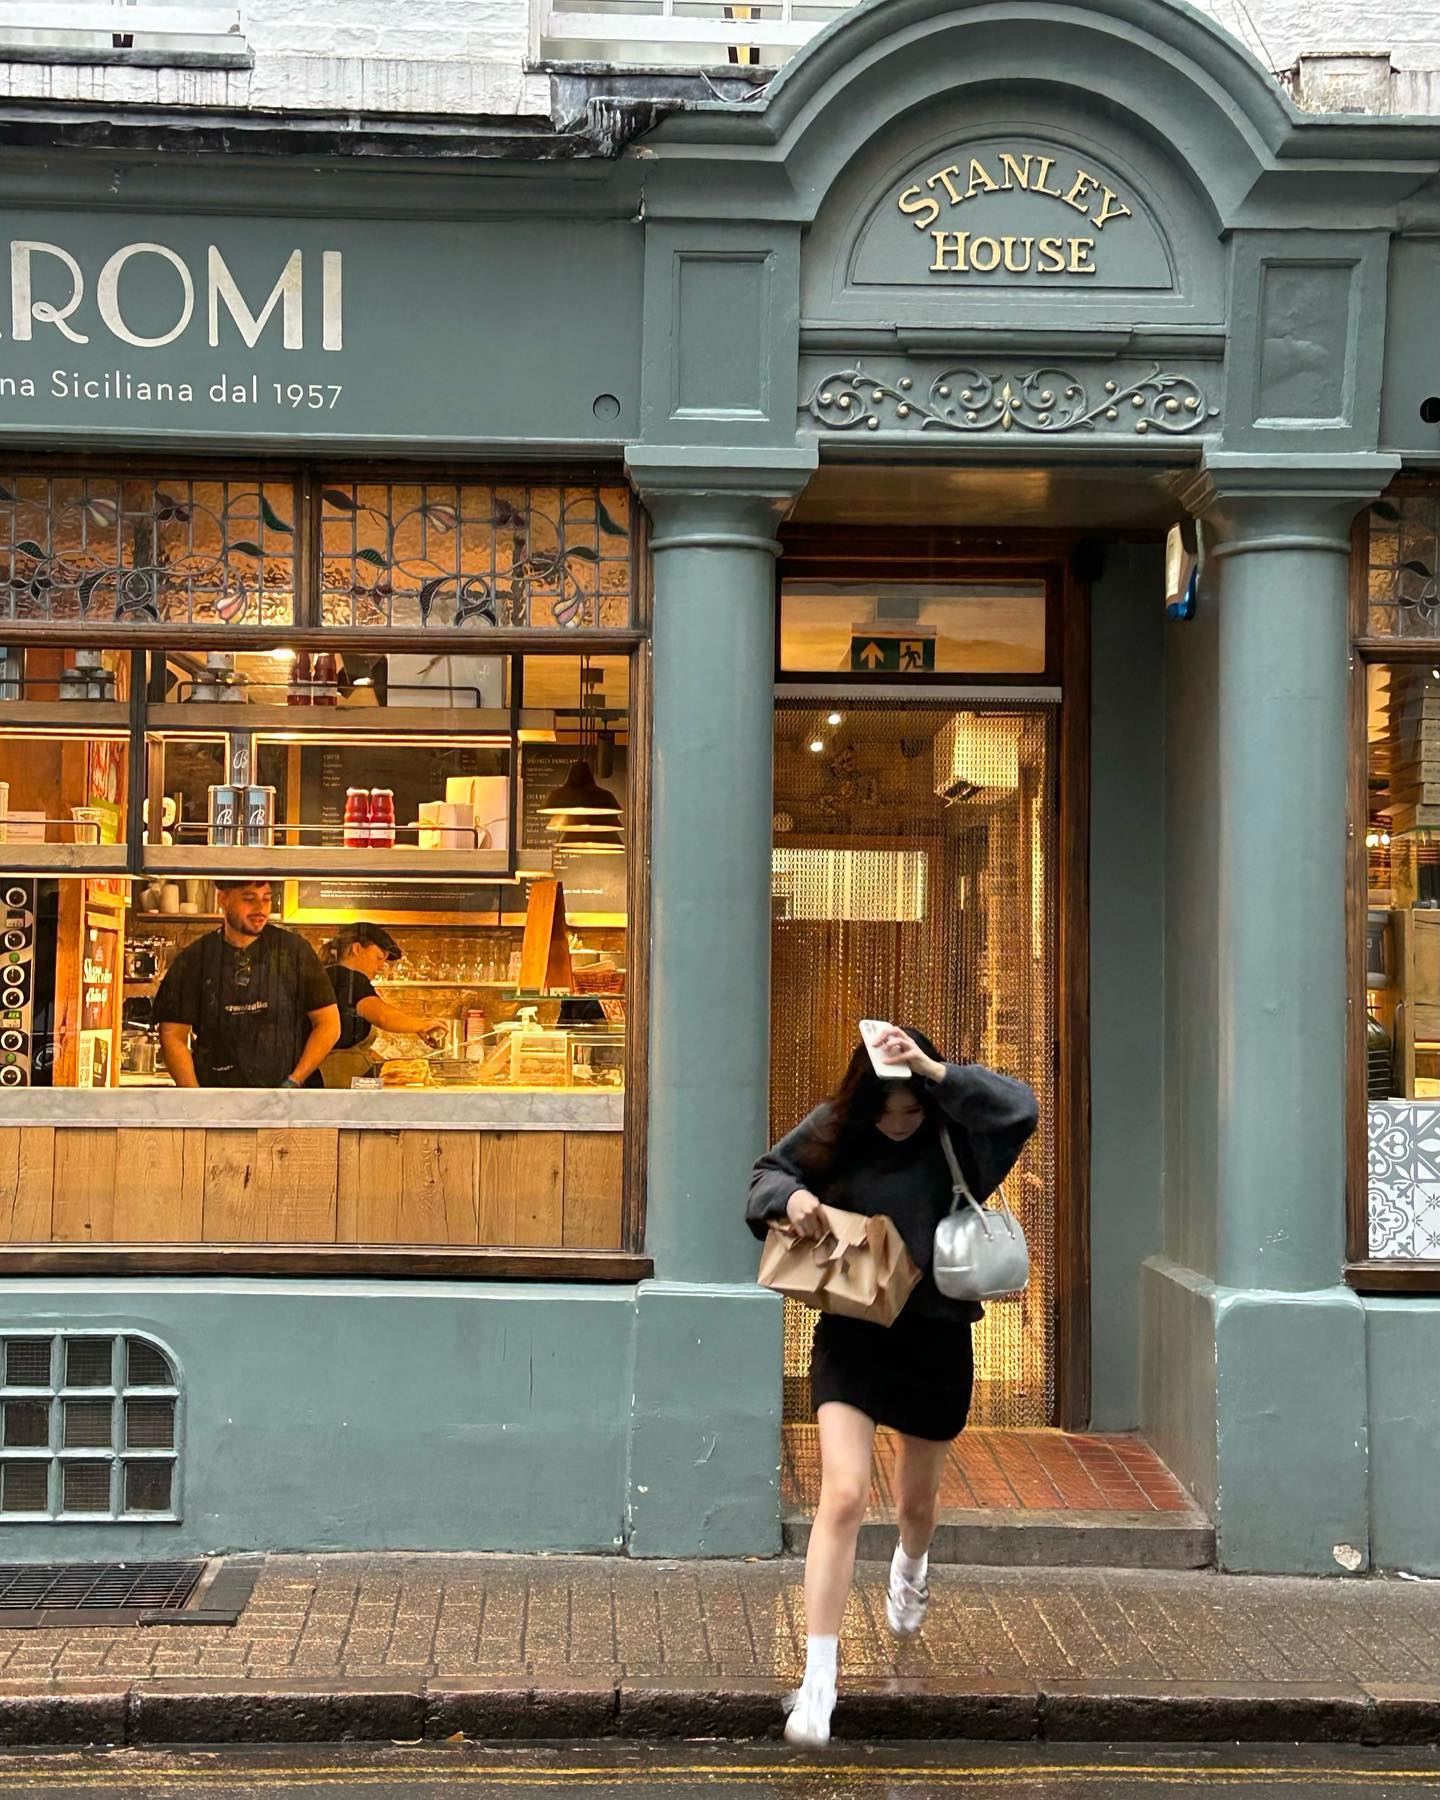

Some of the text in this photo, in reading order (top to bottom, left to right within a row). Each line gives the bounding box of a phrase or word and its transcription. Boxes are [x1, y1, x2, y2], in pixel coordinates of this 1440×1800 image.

[898, 153, 1132, 229] STANLEY
[929, 231, 1096, 273] HOUSE
[0, 241, 343, 352] ROMI
[50, 369, 193, 402] Siciliana
[209, 373, 258, 404] dal
[273, 383, 343, 409] 1957
